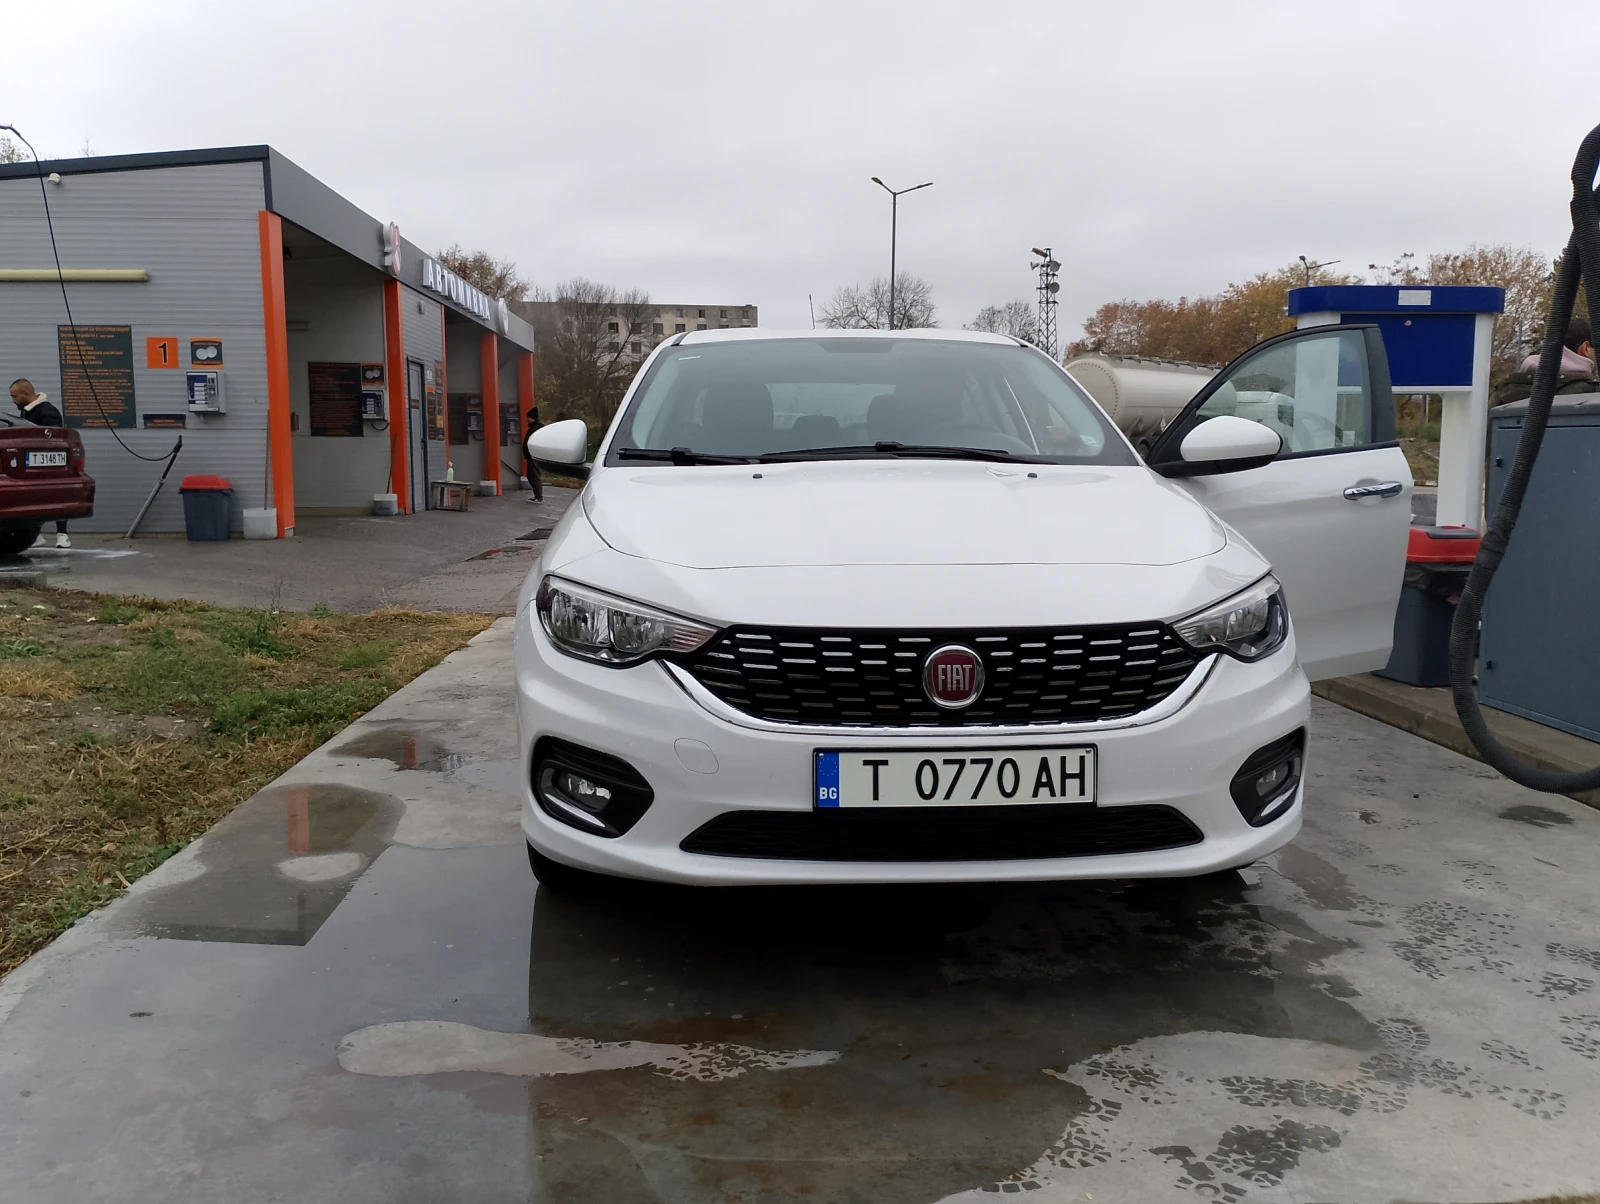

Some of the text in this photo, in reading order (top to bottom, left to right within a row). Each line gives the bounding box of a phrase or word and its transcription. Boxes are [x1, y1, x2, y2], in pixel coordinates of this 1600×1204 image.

[424, 258, 491, 321] АВТОМИВКА
[157, 341, 168, 364] 1
[937, 664, 972, 691] FIAT
[862, 755, 1086, 801] T 0770 AH
[819, 787, 838, 800] BG
